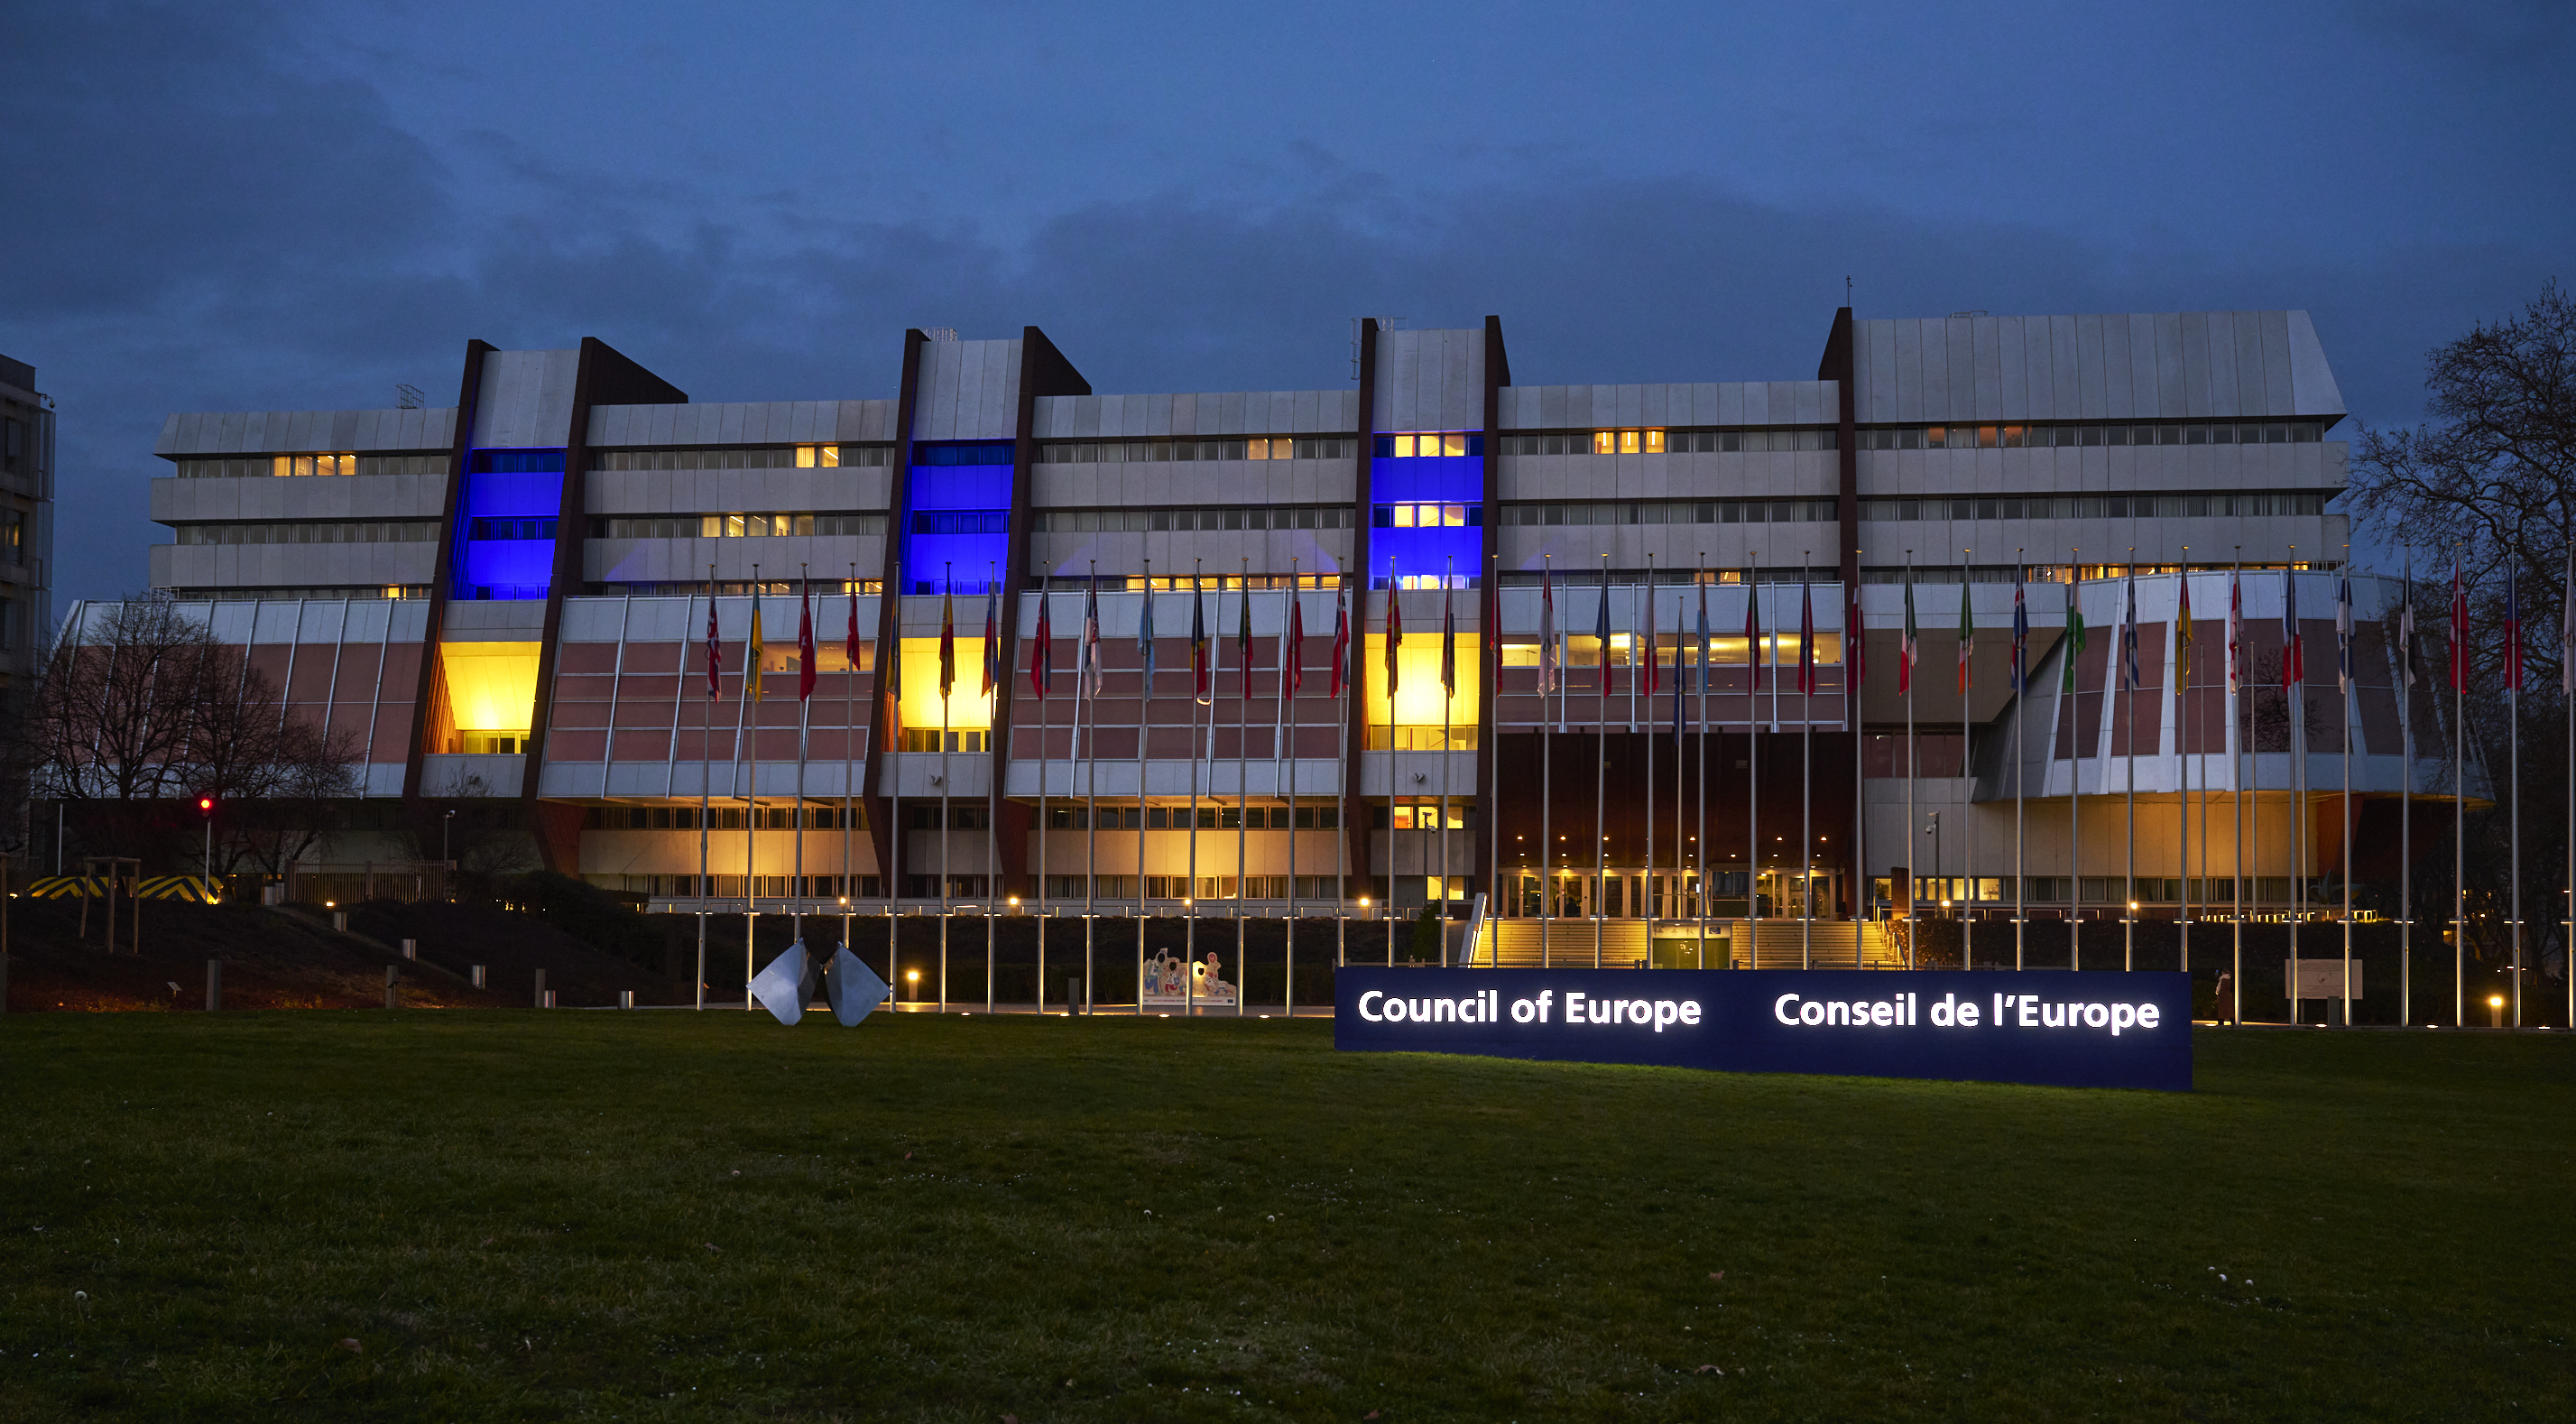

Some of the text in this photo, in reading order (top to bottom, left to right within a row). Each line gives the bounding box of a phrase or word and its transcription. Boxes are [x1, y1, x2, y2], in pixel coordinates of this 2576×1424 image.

[1358, 989, 1702, 1033] Council of Europe
[1774, 993, 2160, 1036] Conseil de l’Europe
